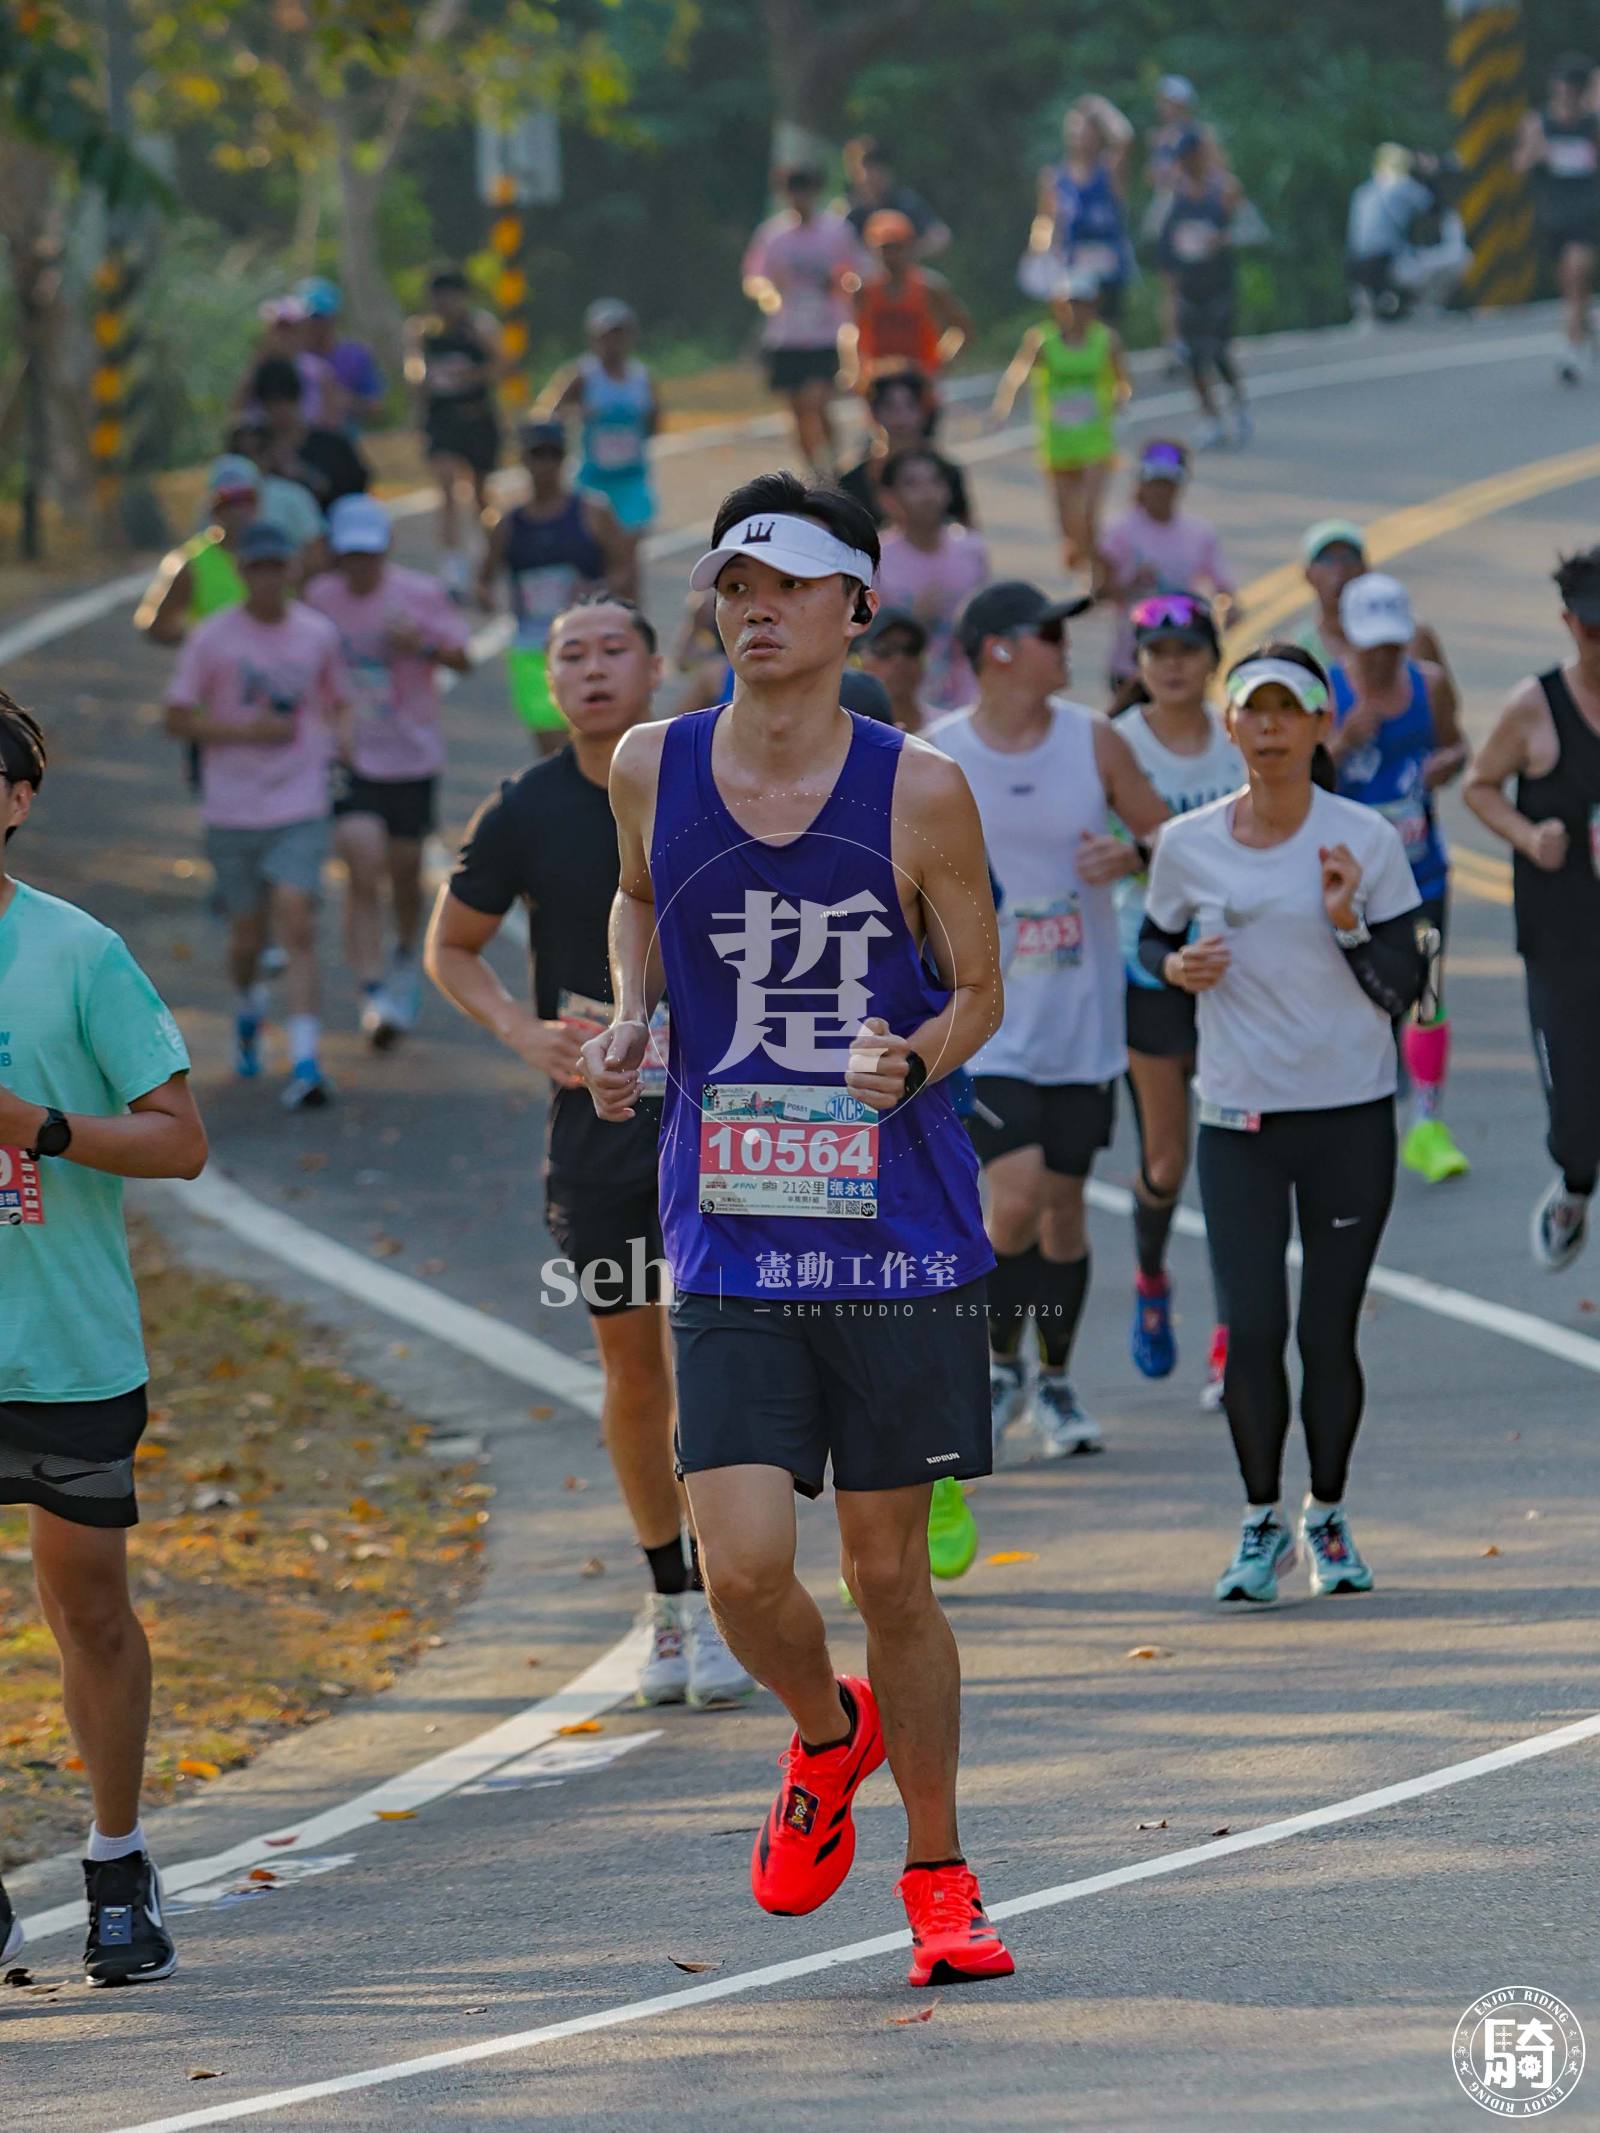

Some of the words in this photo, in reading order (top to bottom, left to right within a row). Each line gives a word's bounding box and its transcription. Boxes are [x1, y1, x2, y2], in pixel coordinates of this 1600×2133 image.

[708, 1127, 873, 1174] 10564
[783, 1181, 825, 1195] 21公里
[829, 1180, 874, 1197] 張永松
